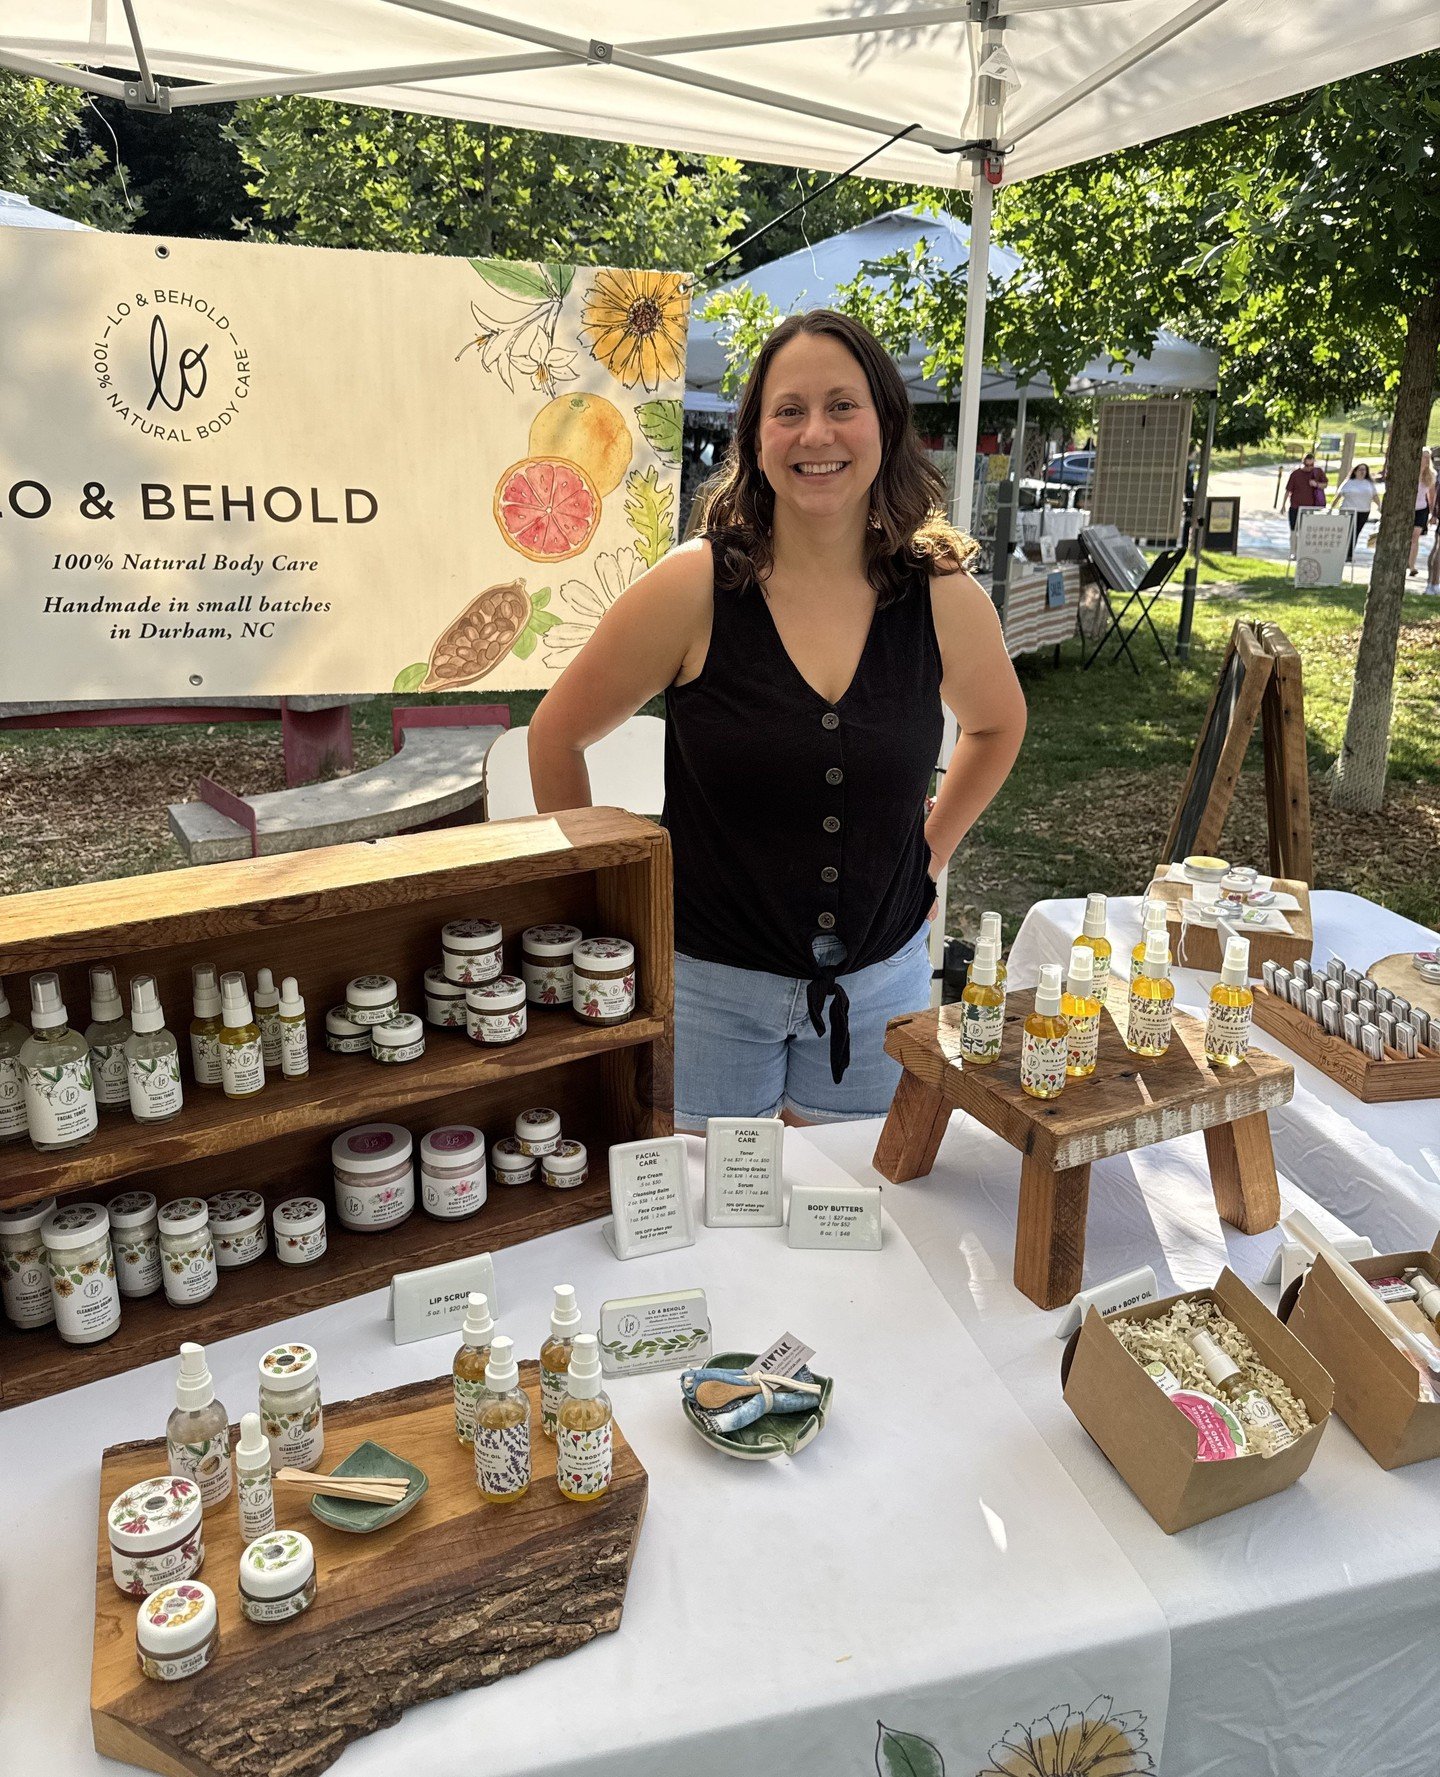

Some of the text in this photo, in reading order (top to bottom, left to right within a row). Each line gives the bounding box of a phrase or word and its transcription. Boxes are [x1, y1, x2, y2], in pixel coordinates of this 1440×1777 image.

[106, 289, 230, 331] LO & BEHOLD
[146, 313, 210, 411] lo
[93, 341, 251, 442] 100% NATURAL BODY CARE
[0, 479, 379, 524] O & BEHOLD
[52, 552, 319, 576] 100% Natural Body Care
[43, 596, 332, 613] Handmade in small batches
[110, 622, 275, 641] in Durham, NC
[57, 1114, 73, 1122] FACIAL
[635, 1152, 660, 1160] FACIAL
[639, 1159, 658, 1167] CARE
[633, 1190, 656, 1198] Cleansing
[830, 1205, 864, 1213] BUTTERS
[429, 1291, 471, 1305] LIP SCRUB
[1101, 1304, 1118, 1316] HAIR
[1123, 1295, 1140, 1308] BODY
[1141, 1290, 1152, 1300] OIL
[76, 1304, 100, 1316] CLEANSING
[449, 1304, 461, 1313] $20
[1197, 1404, 1214, 1429] SALVE
[279, 1444, 301, 1452] CLEANSING
[1211, 1430, 1226, 1453] HAND
[564, 1452, 577, 1460] HAIR
[584, 1453, 600, 1461] BODY
[152, 1570, 175, 1582] CLEANSING
